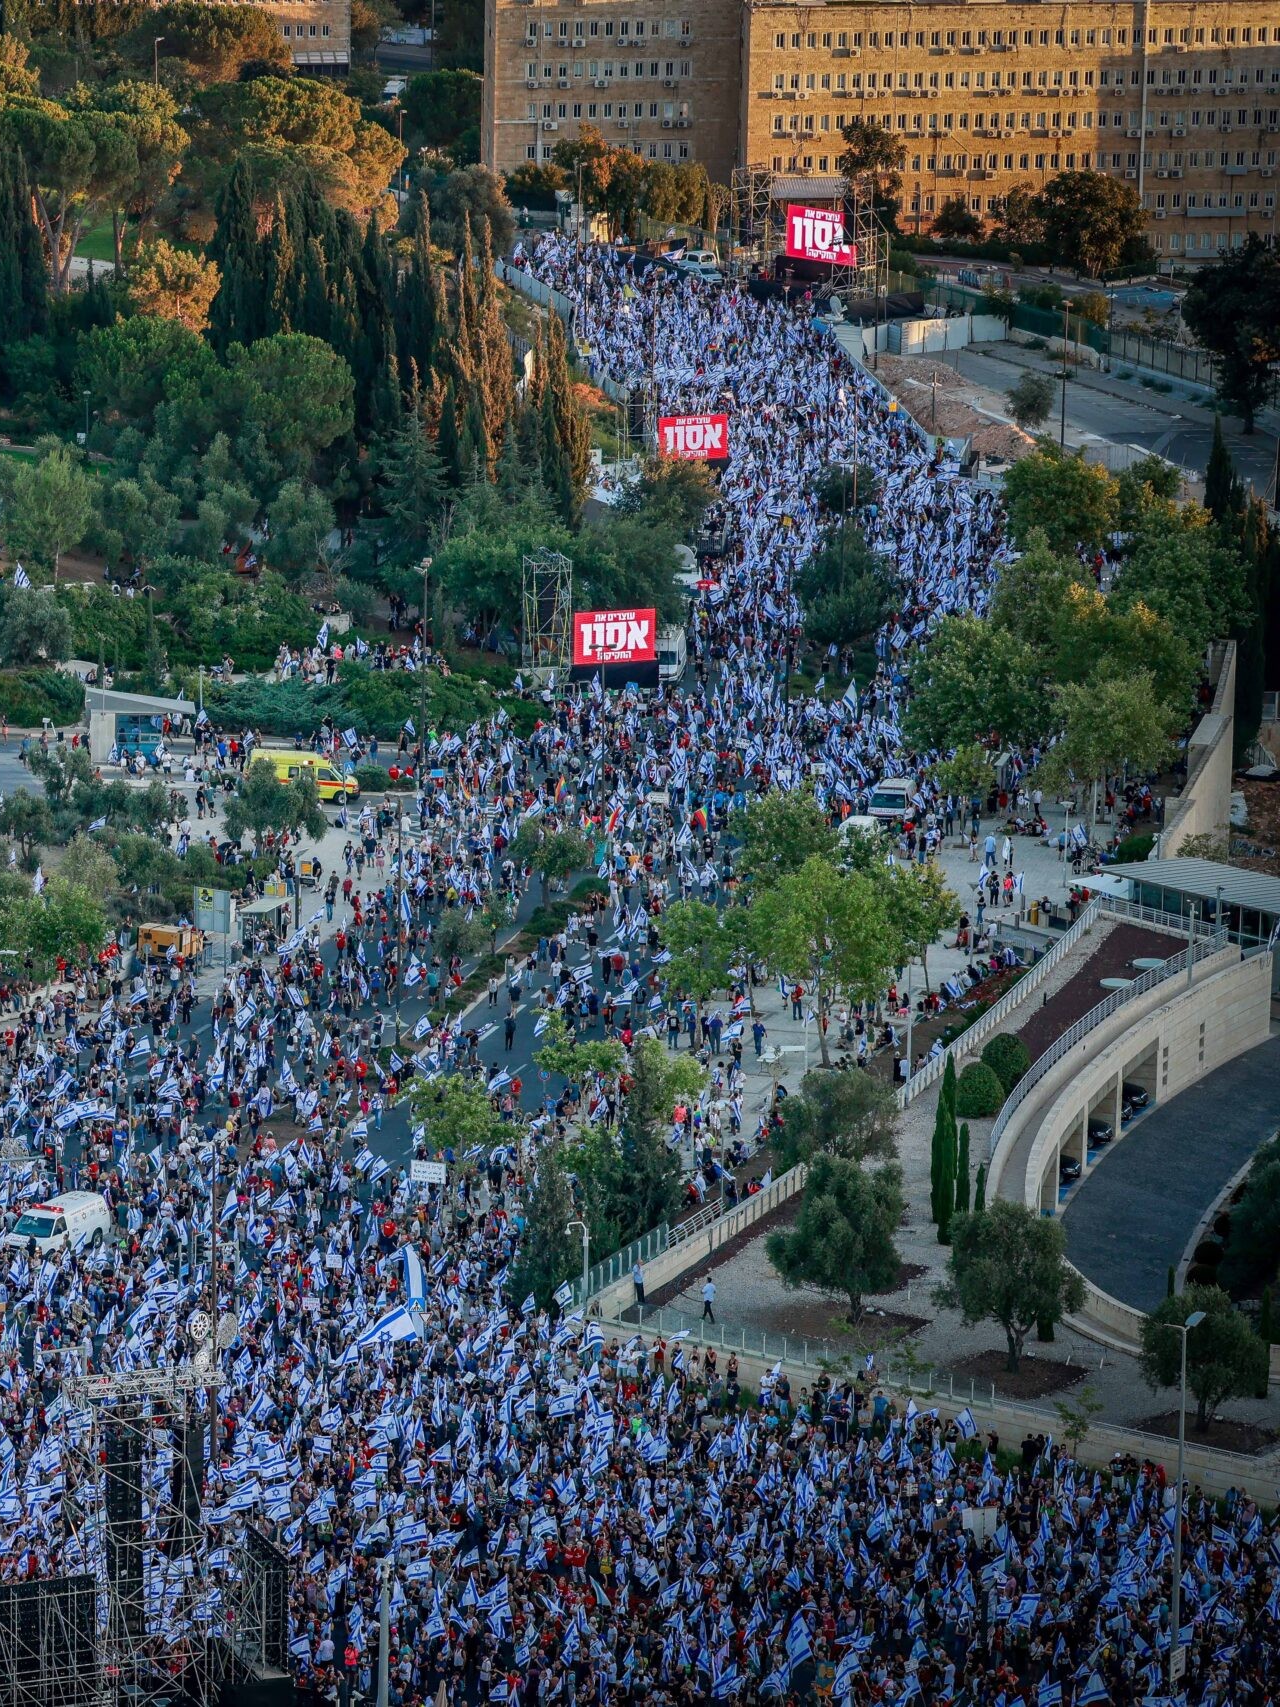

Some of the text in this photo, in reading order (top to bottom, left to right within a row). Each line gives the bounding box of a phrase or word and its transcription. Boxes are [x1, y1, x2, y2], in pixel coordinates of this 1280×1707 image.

[805, 209, 815, 218] את
[792, 216, 850, 254] אסון
[664, 423, 722, 454] אסון
[595, 612, 636, 622] עוצרים את
[581, 620, 649, 656] אסון
